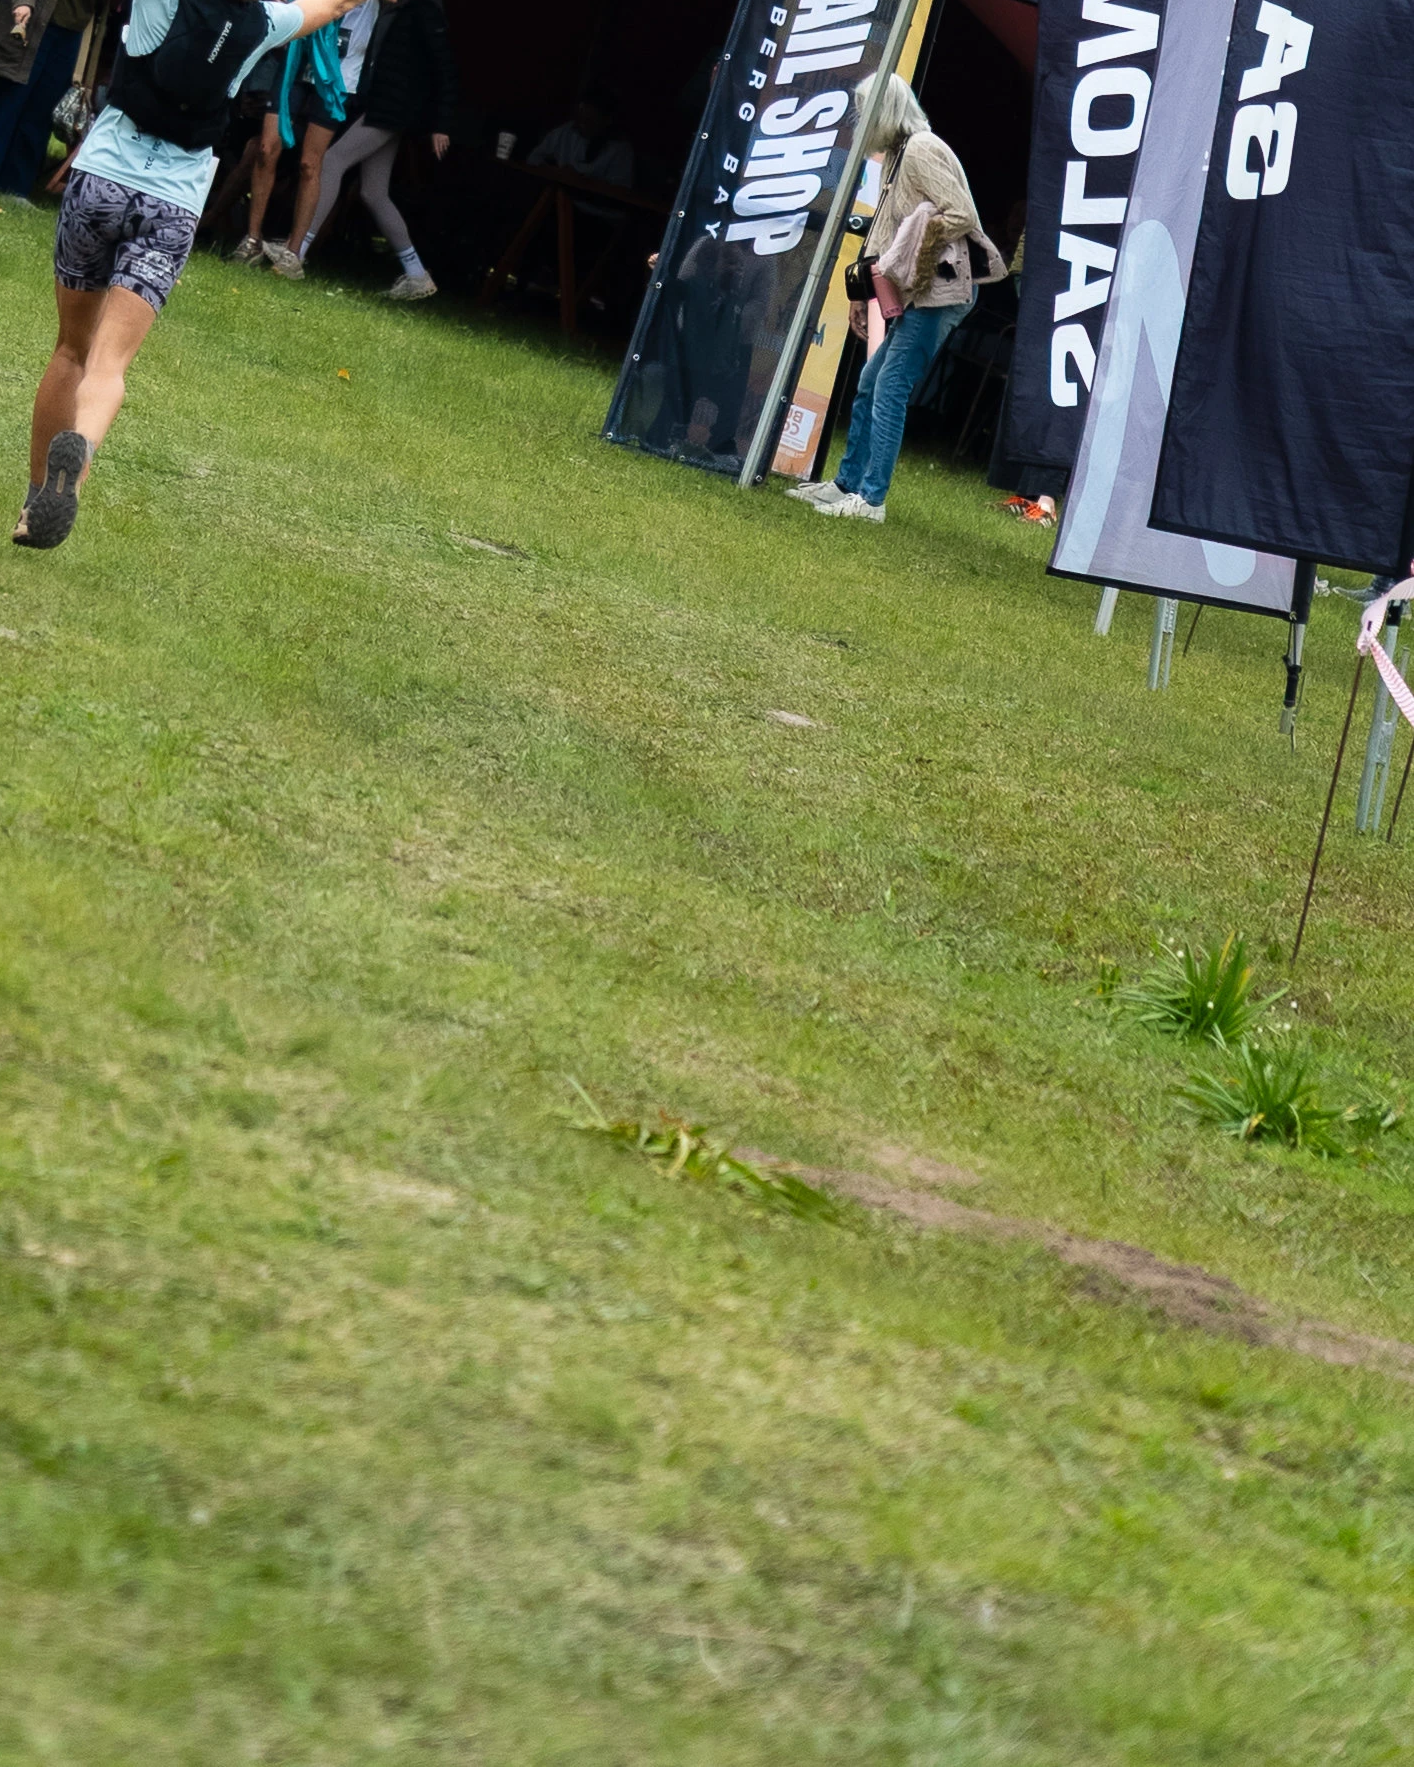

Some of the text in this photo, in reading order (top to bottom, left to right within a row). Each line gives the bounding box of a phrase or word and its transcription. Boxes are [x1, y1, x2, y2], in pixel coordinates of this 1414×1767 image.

[207, 20, 233, 64] SALOMON
[703, 152, 739, 240] BAY
[725, 89, 850, 258] SHOP
